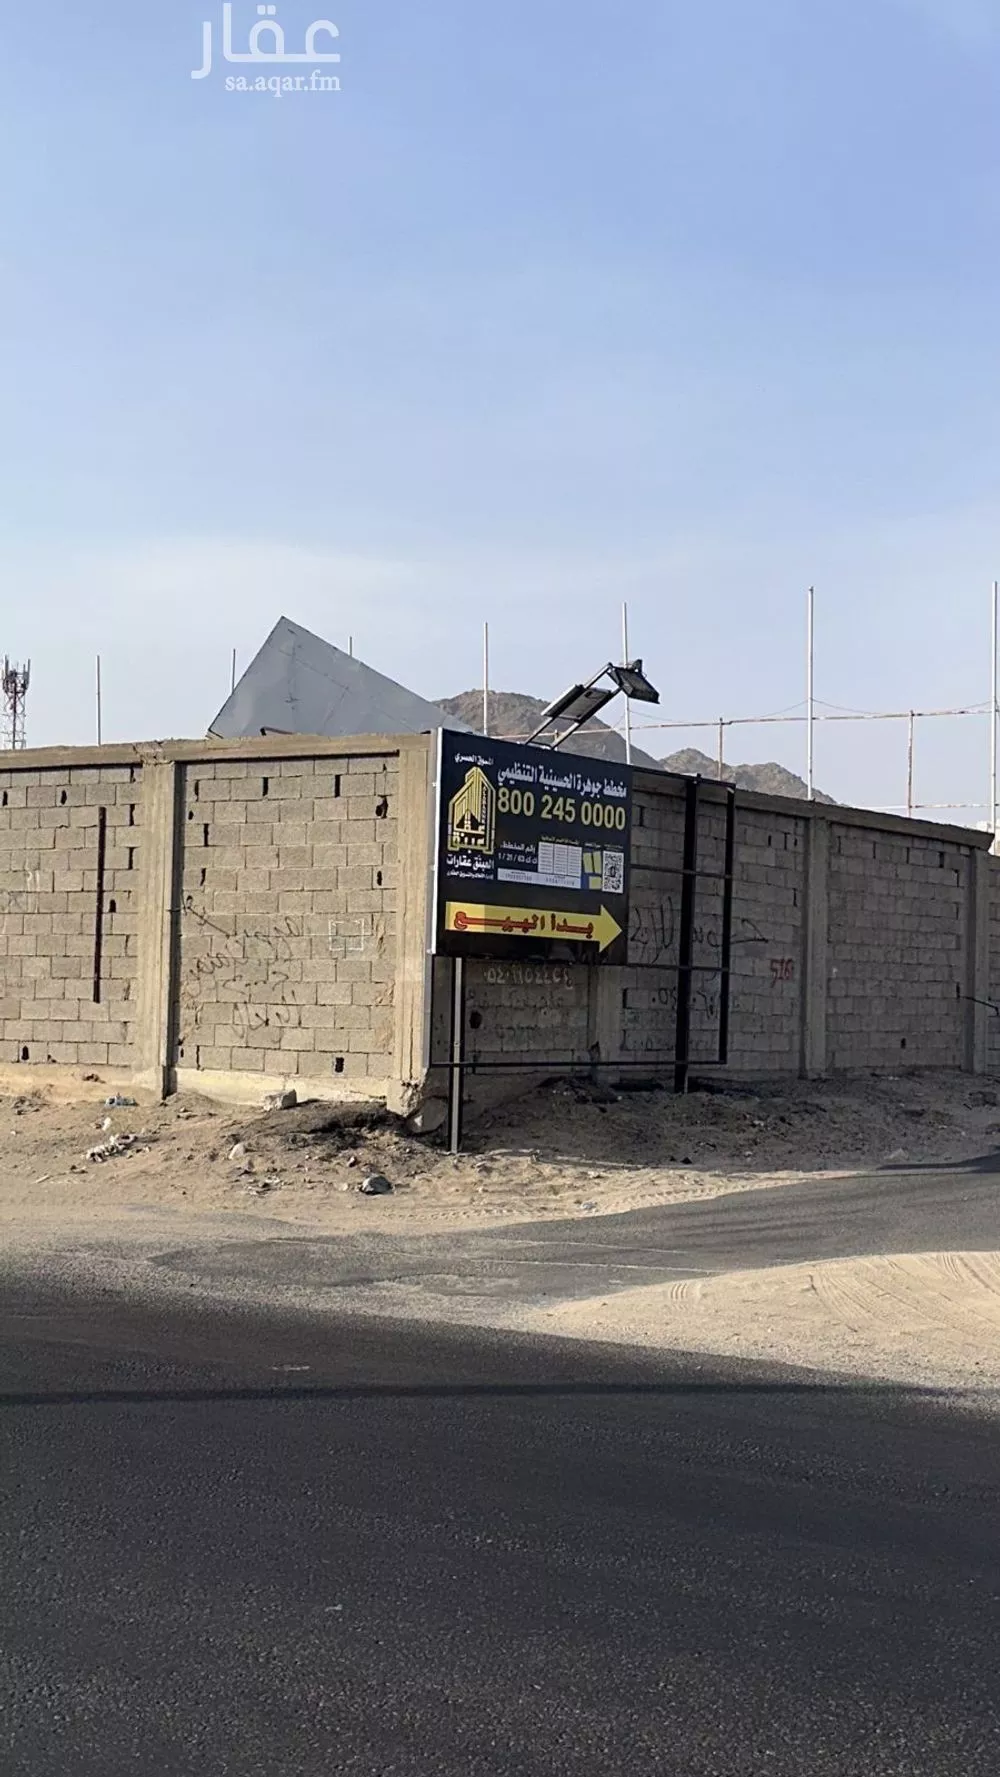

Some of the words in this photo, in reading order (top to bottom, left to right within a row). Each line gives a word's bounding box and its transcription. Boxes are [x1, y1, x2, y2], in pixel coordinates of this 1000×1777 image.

[497, 762, 538, 787] التنظيمي
[539, 765, 576, 792] الحسينية
[576, 774, 602, 798] جوهرة
[603, 778, 627, 798] مخطط
[497, 786, 535, 816] 800
[540, 794, 576, 823] 245
[581, 801, 626, 831] 0000
